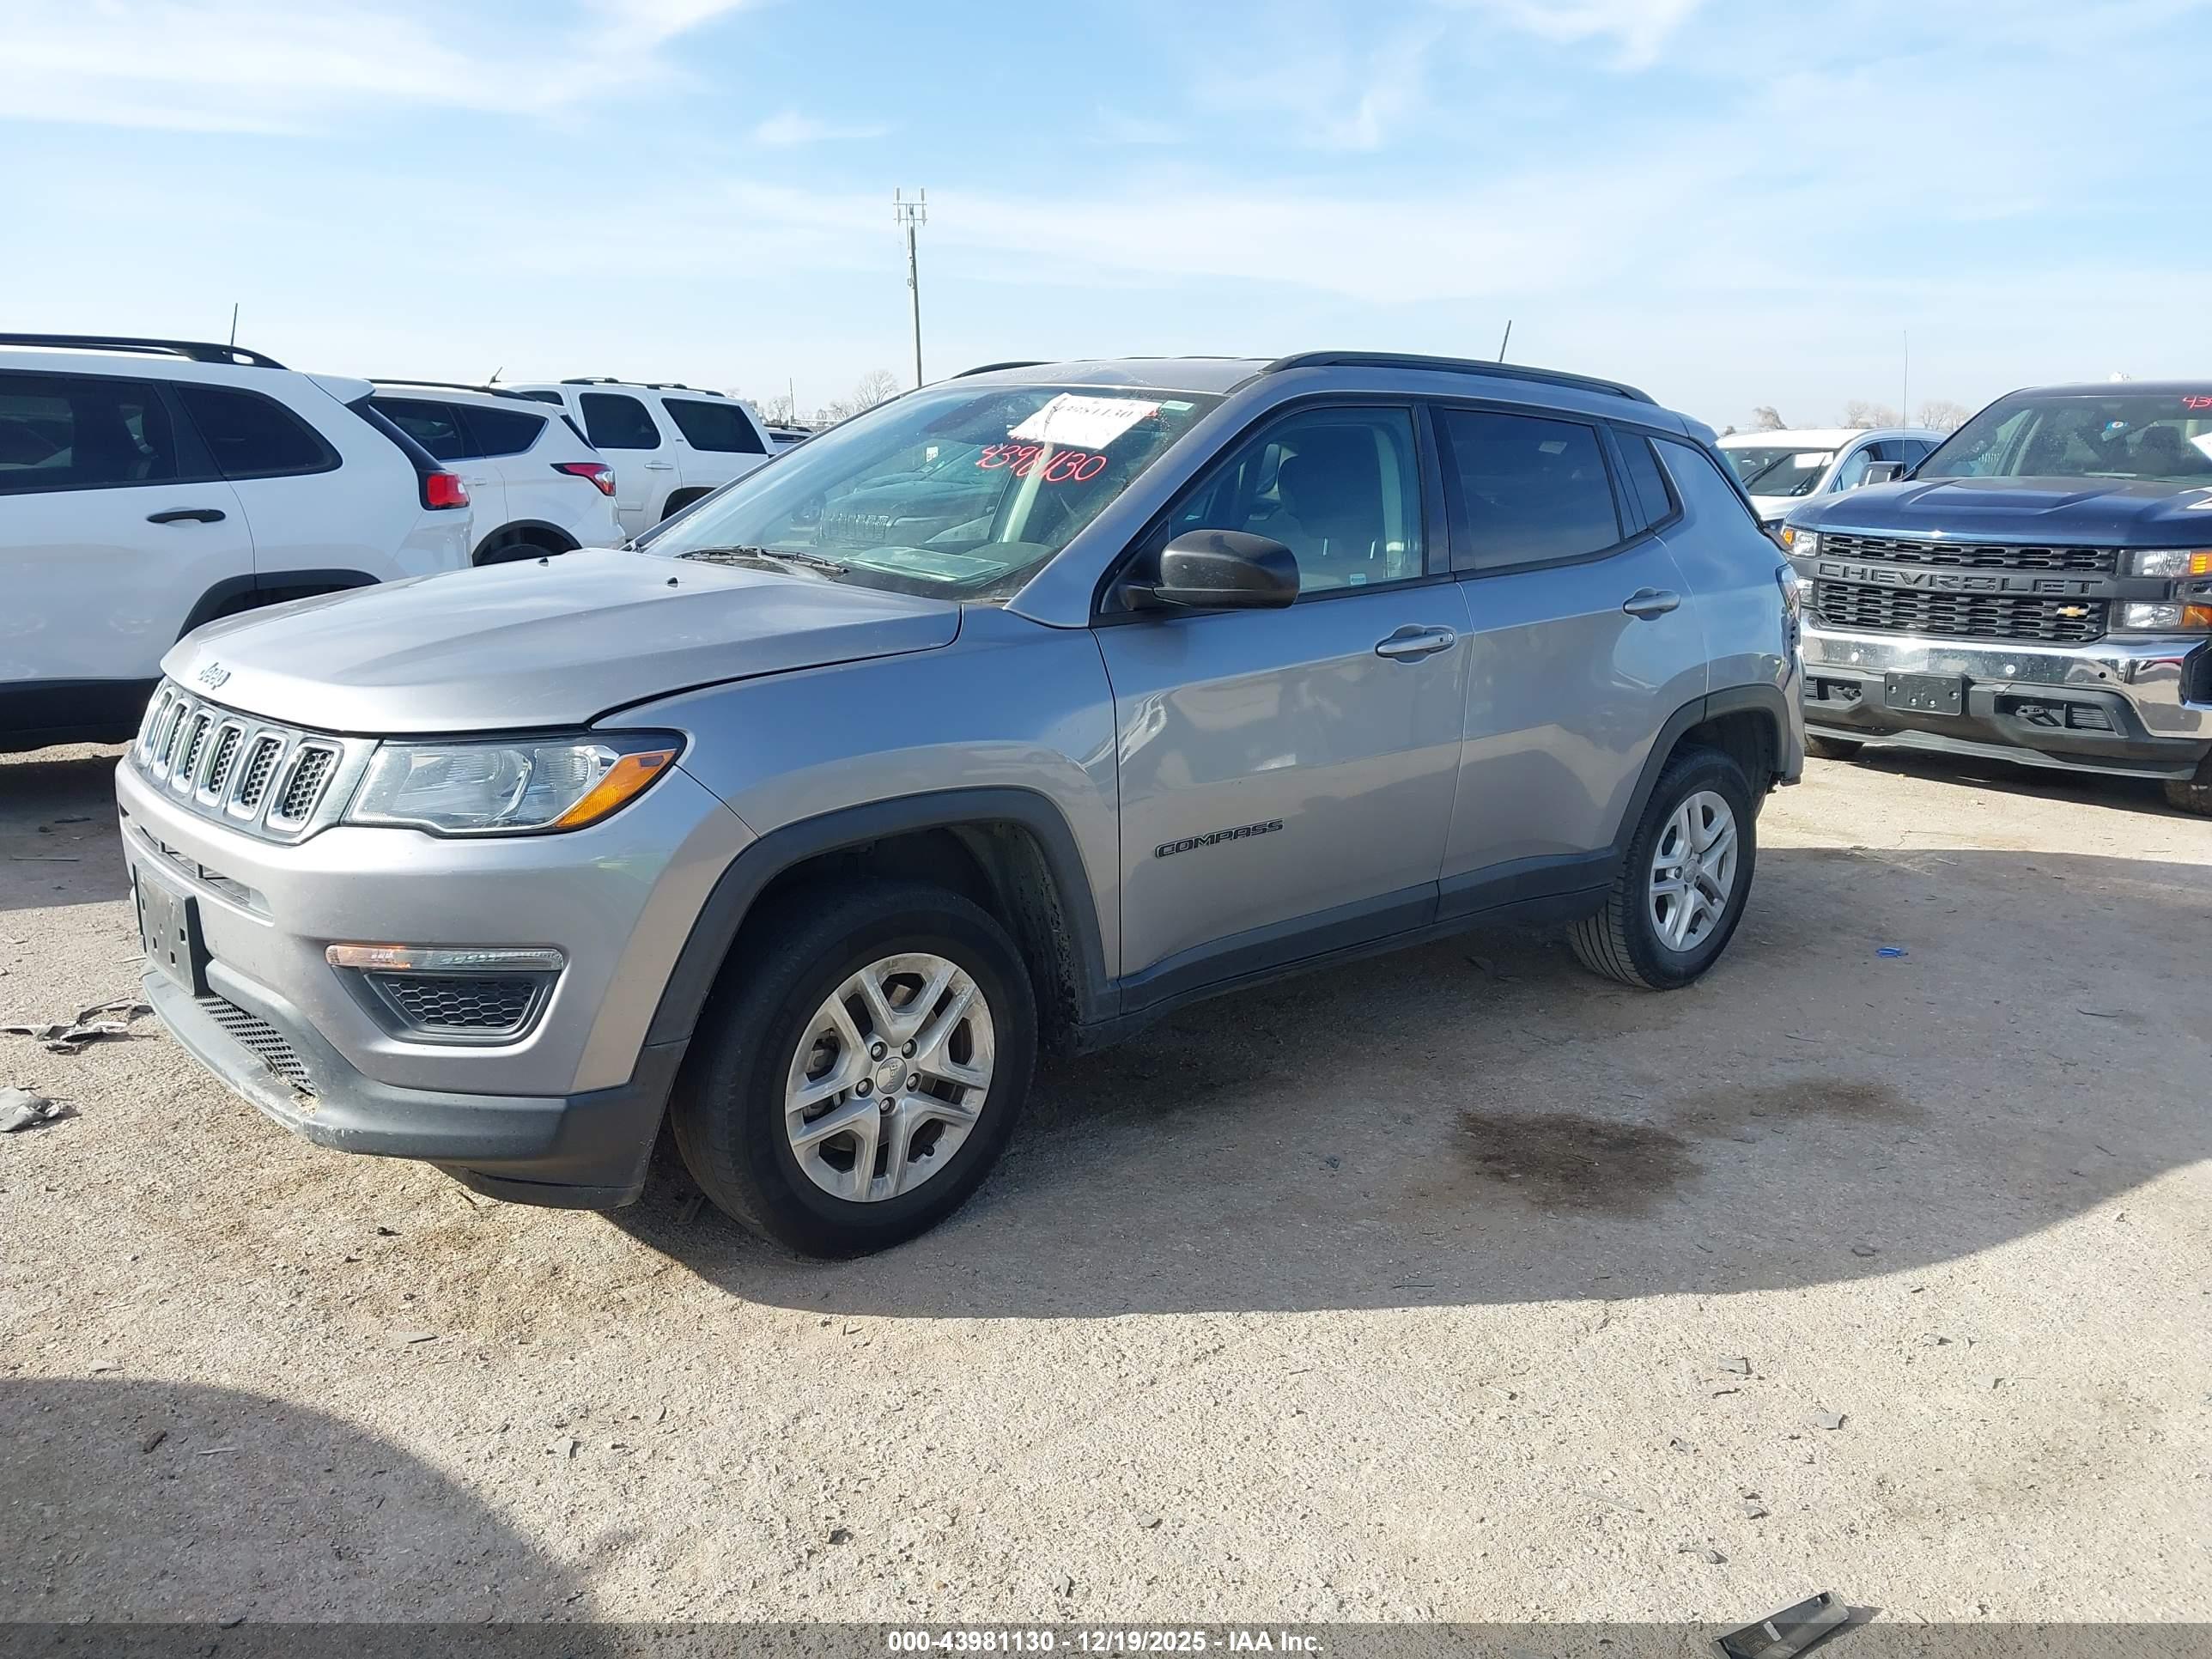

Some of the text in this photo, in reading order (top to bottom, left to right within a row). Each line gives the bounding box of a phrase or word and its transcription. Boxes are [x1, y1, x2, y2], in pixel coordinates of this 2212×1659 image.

[1818, 562, 2104, 595] CHEVROLET
[197, 661, 232, 691] Jeep
[1155, 818, 1284, 859] COMPASS
